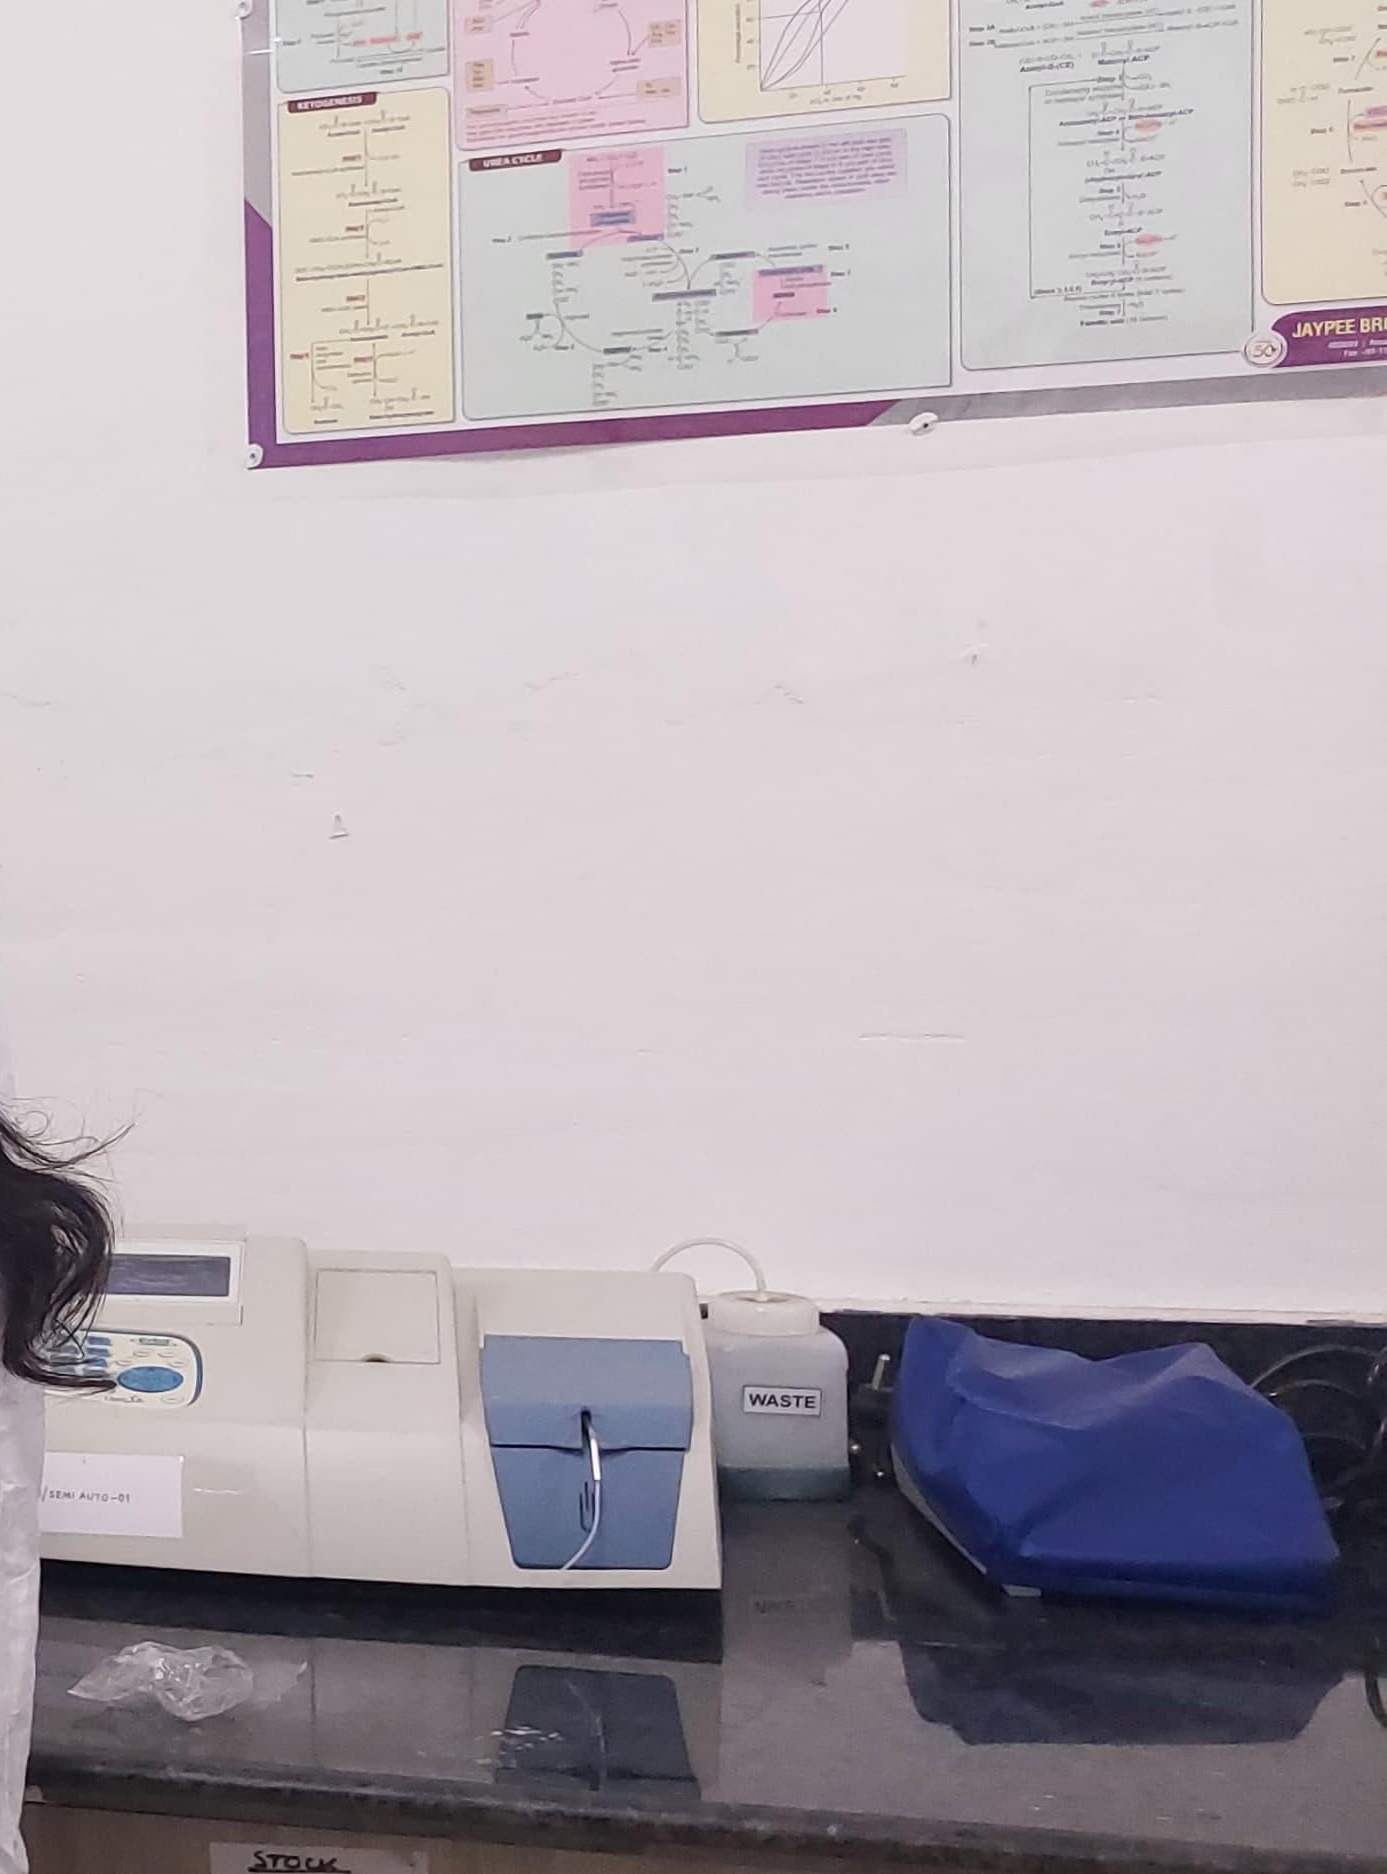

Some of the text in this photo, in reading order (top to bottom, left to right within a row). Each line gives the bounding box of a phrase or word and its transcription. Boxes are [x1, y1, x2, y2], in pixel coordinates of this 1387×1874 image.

[1292, 319, 1356, 338] JAYPEE
[749, 1393, 817, 1409] WASTE
[253, 1850, 339, 1871] STOCK
